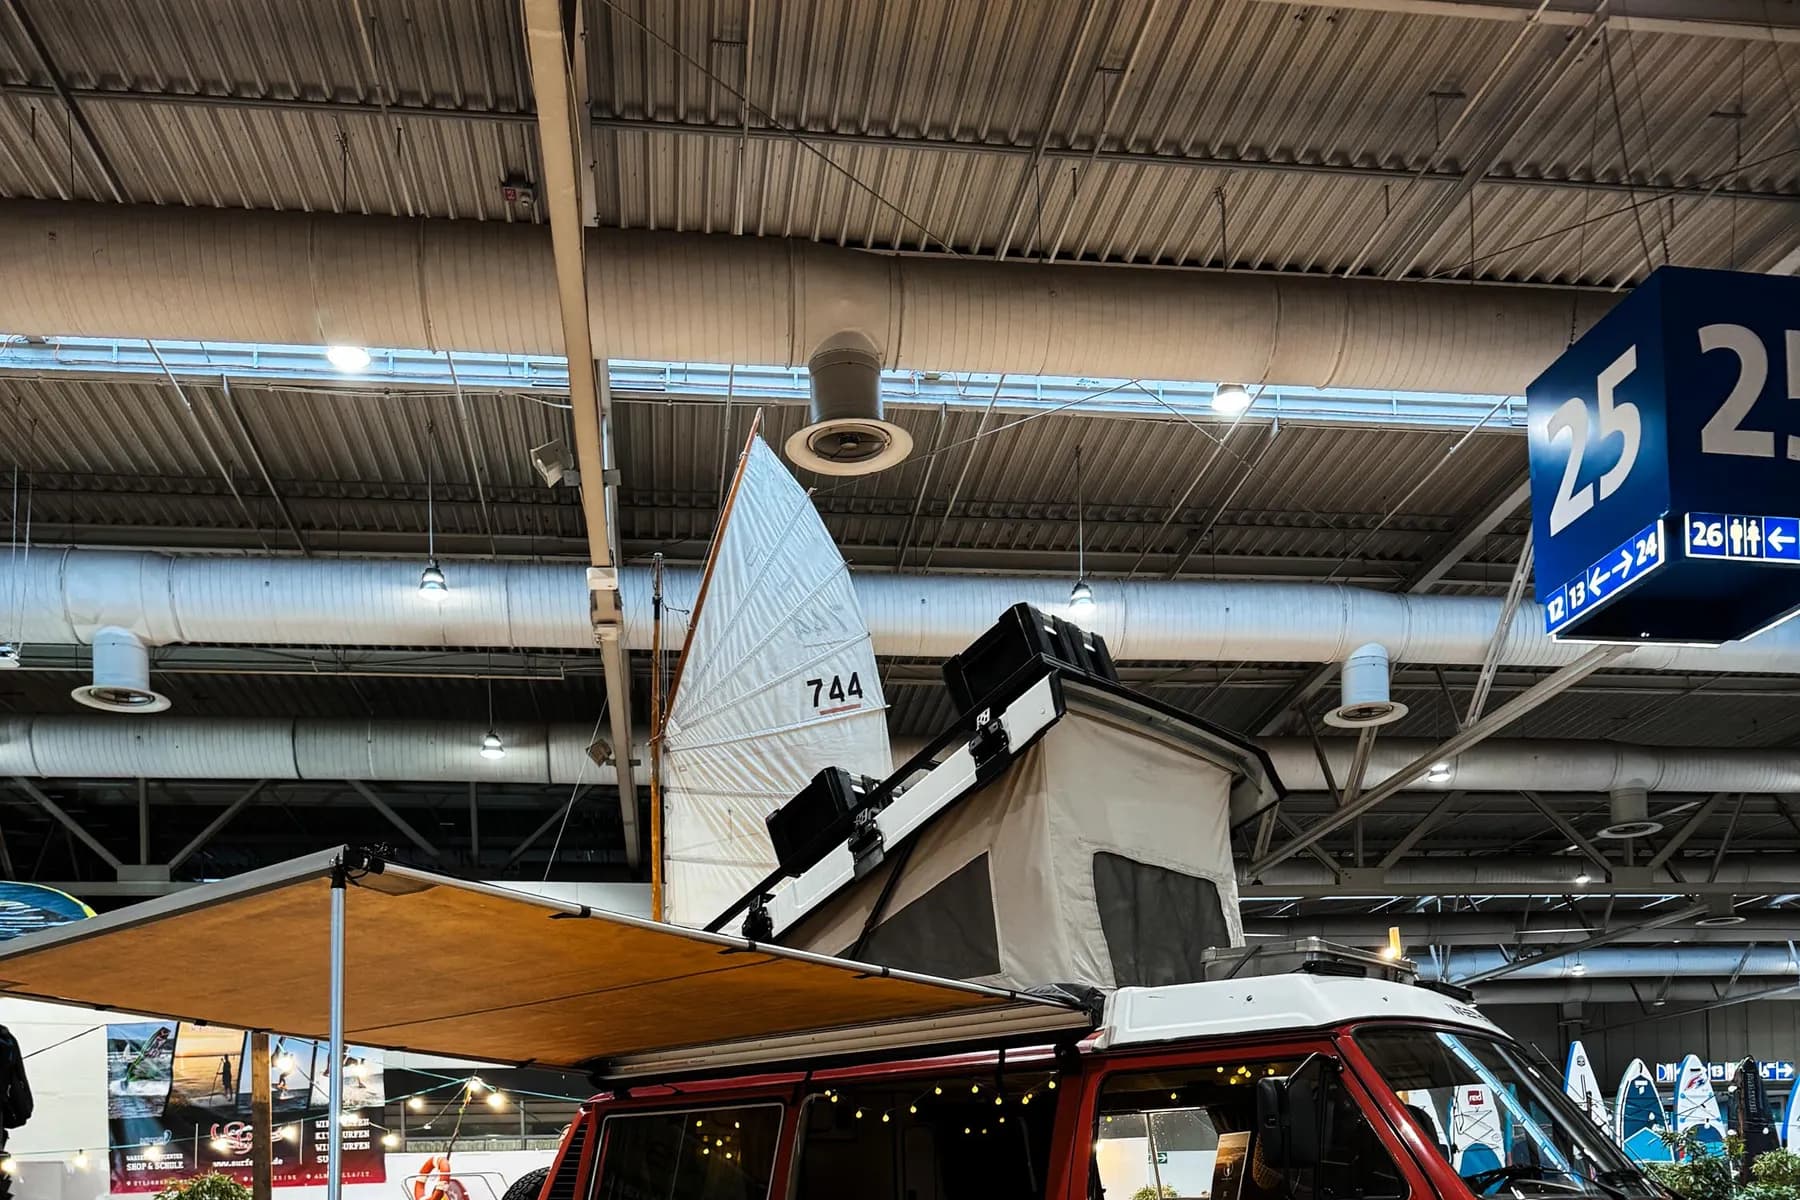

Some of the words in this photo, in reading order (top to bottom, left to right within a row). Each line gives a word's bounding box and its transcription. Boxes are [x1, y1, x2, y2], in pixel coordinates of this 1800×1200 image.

[1698, 323, 1800, 460] 2
[1547, 344, 1641, 537] 25
[1547, 596, 1564, 624] 12
[1569, 581, 1586, 610] 13
[1635, 531, 1657, 566] 24
[1692, 521, 1723, 548] 26
[807, 671, 863, 707] 744
